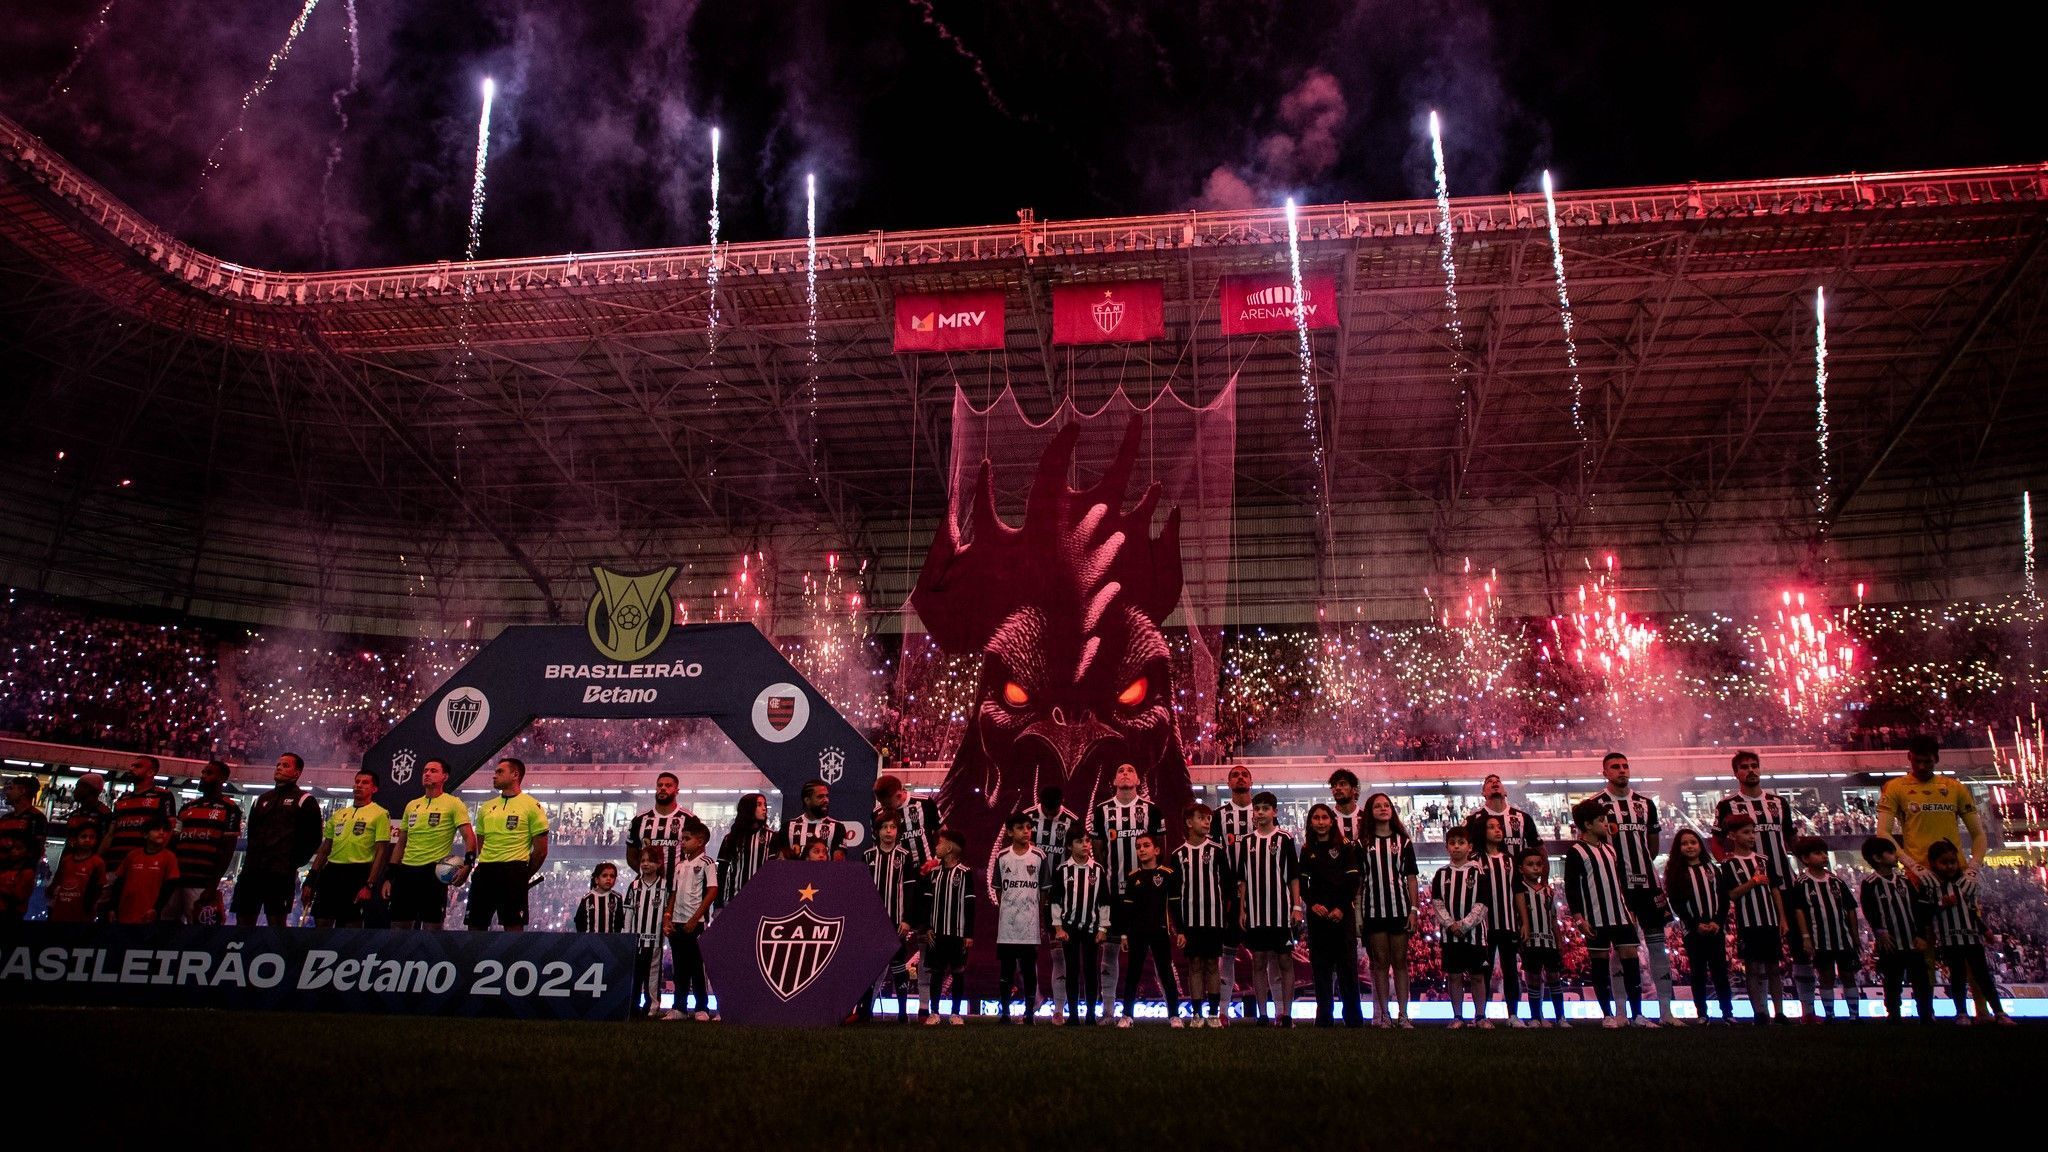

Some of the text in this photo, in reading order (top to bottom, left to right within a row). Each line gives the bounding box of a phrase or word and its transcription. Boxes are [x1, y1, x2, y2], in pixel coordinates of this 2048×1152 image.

[938, 310, 986, 329] MRV
[544, 659, 703, 679] BRASILEIRÃO
[582, 685, 658, 704] Betano
[452, 702, 477, 710] CAM
[1009, 880, 1038, 889] BETANO
[770, 925, 830, 939] CAM
[0, 941, 607, 998] ASILEIRÃO Betano 2024
